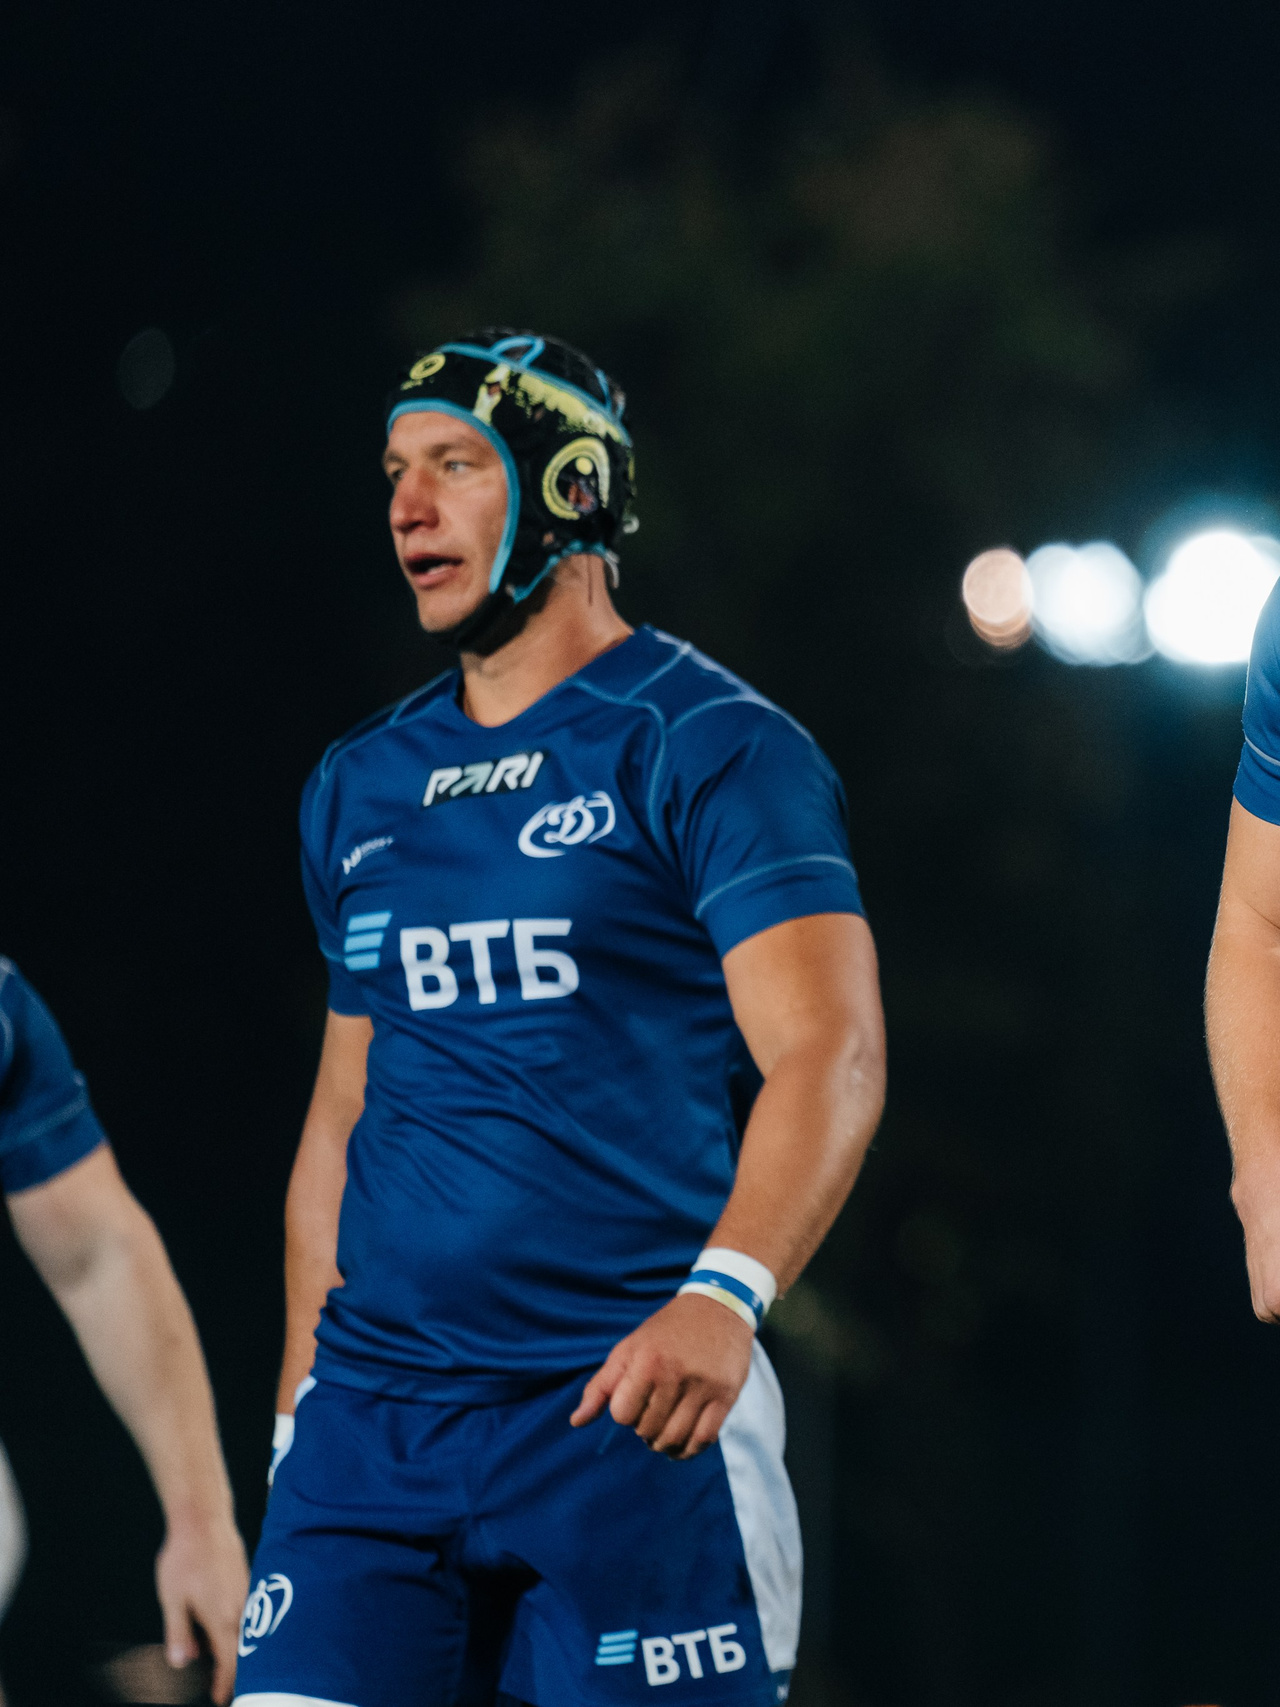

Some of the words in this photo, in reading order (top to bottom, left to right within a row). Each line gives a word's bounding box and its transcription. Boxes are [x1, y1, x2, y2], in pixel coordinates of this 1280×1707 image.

[423, 751, 544, 807] PARI
[400, 918, 580, 1011] ВТБ
[641, 1622, 746, 1687] ВТБ
